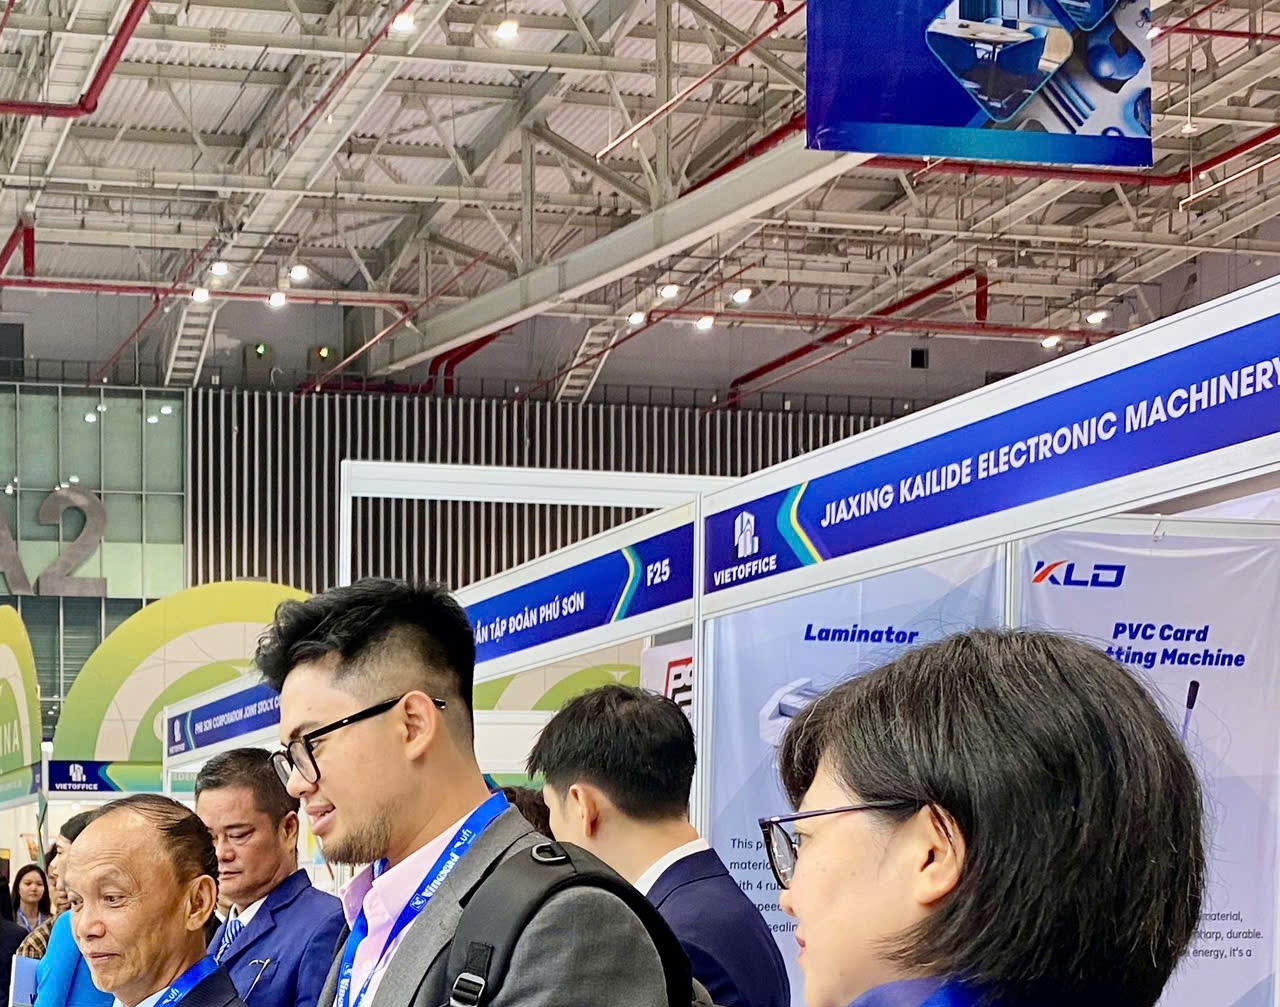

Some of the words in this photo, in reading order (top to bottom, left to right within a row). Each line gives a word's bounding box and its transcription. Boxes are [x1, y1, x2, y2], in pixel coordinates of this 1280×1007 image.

[820, 482, 894, 528] JIAXING
[898, 457, 972, 502] KAILIDE
[976, 412, 1118, 480] ELECTRONIC
[646, 558, 670, 587] F25
[713, 554, 777, 587] VIETOFFICE
[1032, 559, 1127, 588] KLD
[489, 617, 507, 643] TẬP
[508, 606, 538, 634] ĐOÀN
[539, 595, 561, 624] PHÚ
[561, 591, 585, 616] SƠN
[804, 623, 919, 644] Laminator
[1112, 622, 1157, 640] PVC
[1159, 623, 1210, 642] Card
[1160, 648, 1245, 668] Machine
[55, 783, 98, 791] VIETOFFICE
[730, 838, 753, 850] This
[756, 880, 763, 891] 4
[1226, 929, 1264, 939] durable.
[1192, 948, 1227, 959] energy,
[1245, 949, 1252, 957] a
